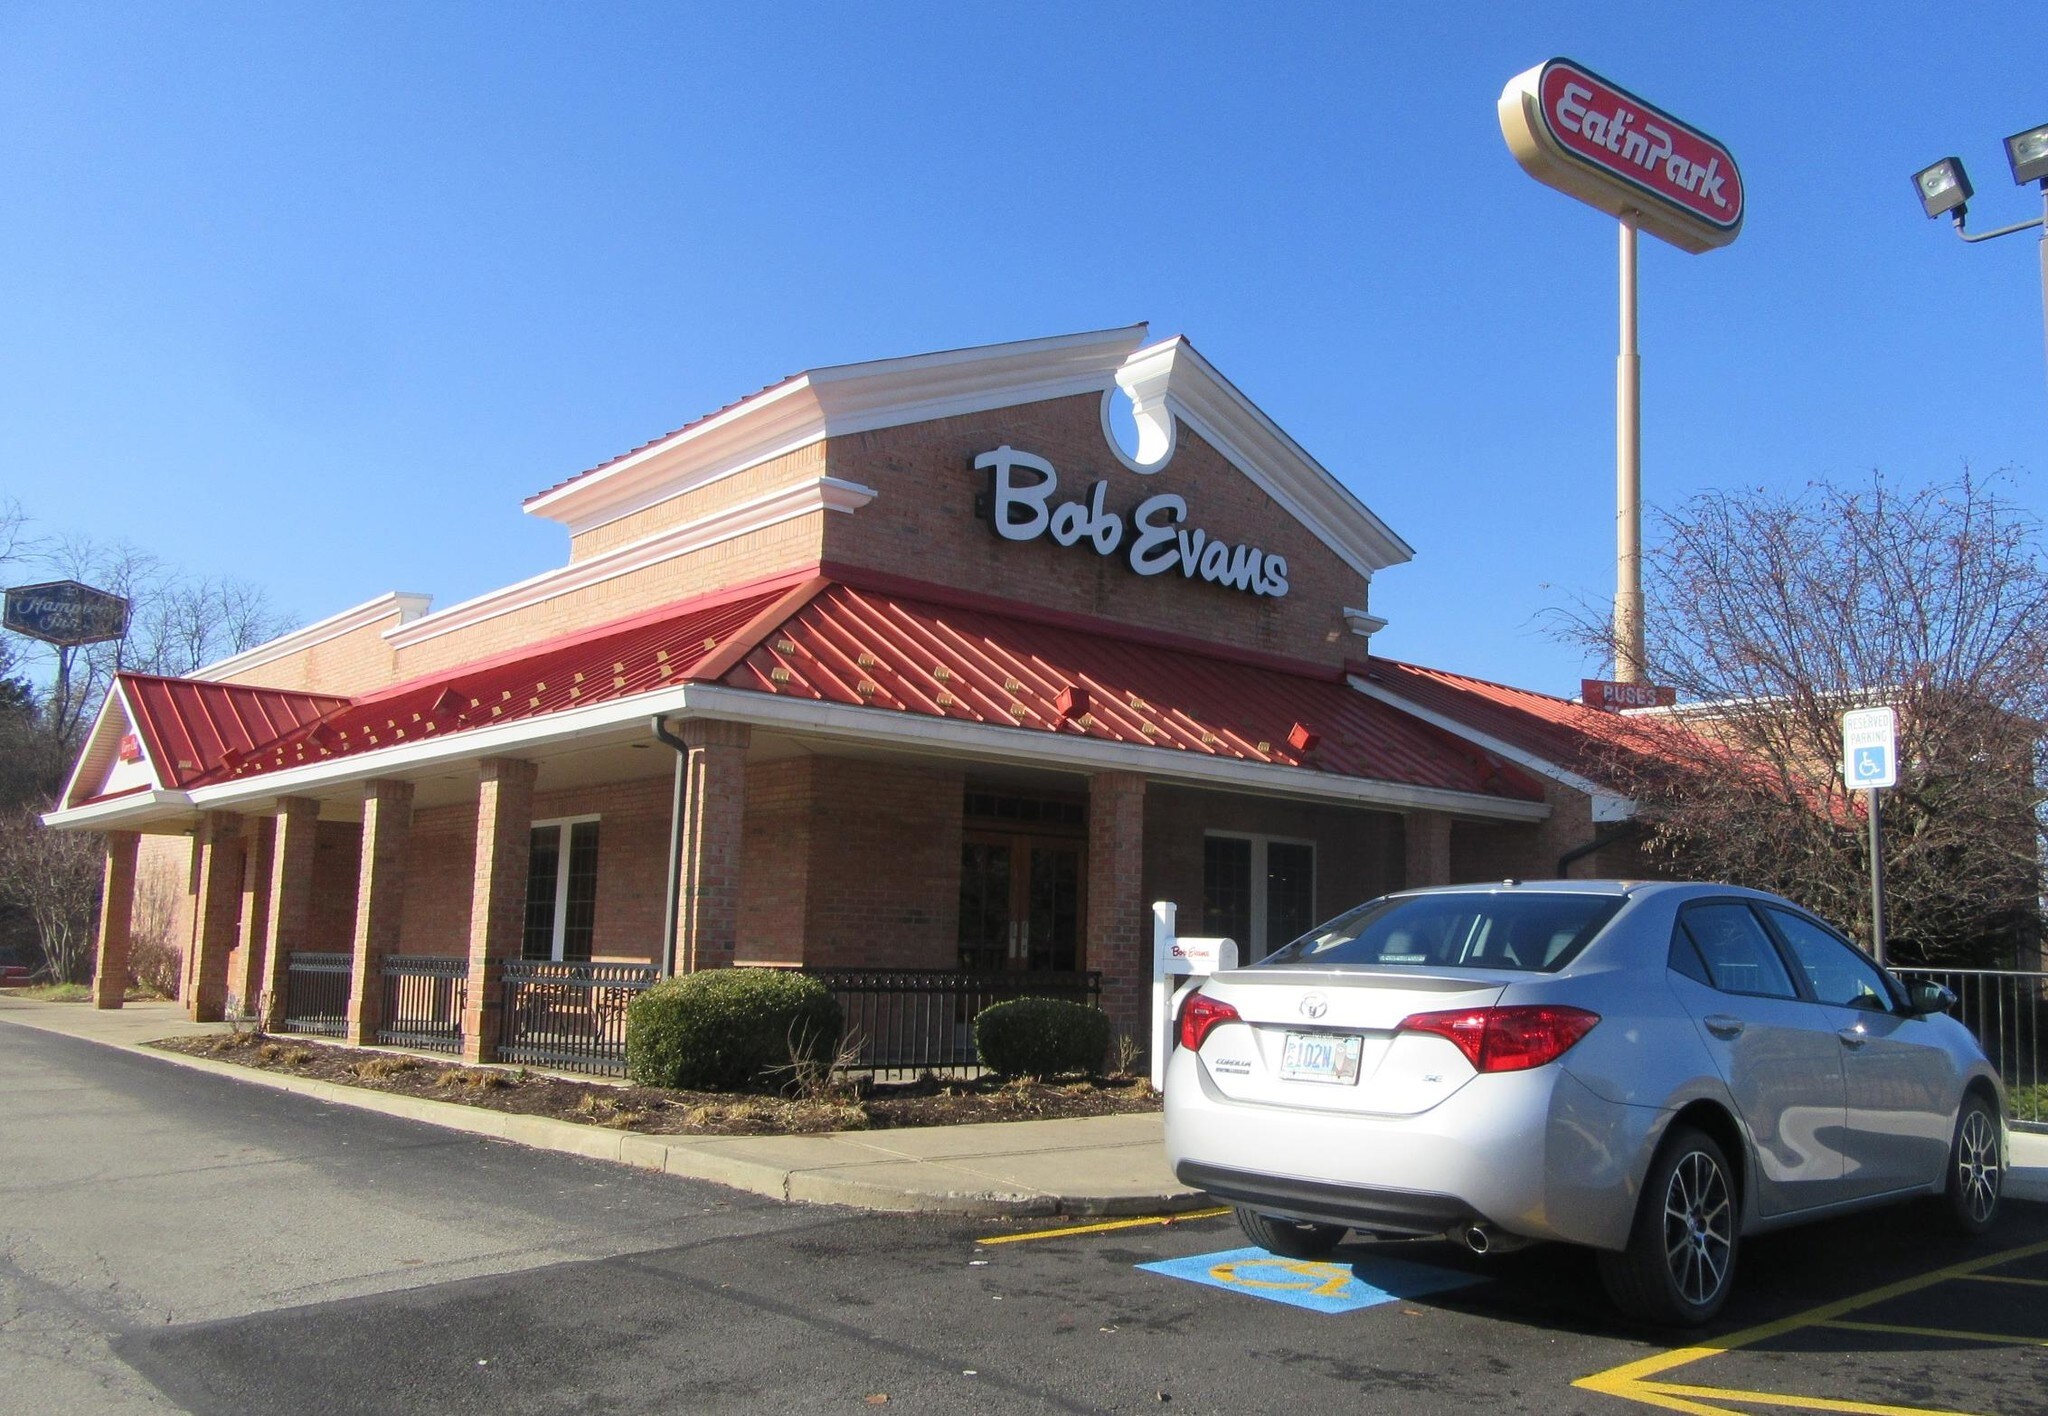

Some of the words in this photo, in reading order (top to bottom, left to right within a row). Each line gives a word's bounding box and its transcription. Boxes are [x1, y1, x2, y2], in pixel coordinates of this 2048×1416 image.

[974, 445, 1122, 555] Bob
[1129, 494, 1289, 597] Evans
[1847, 714, 1889, 731] RESERVED
[1850, 730, 1887, 745] PARKING
